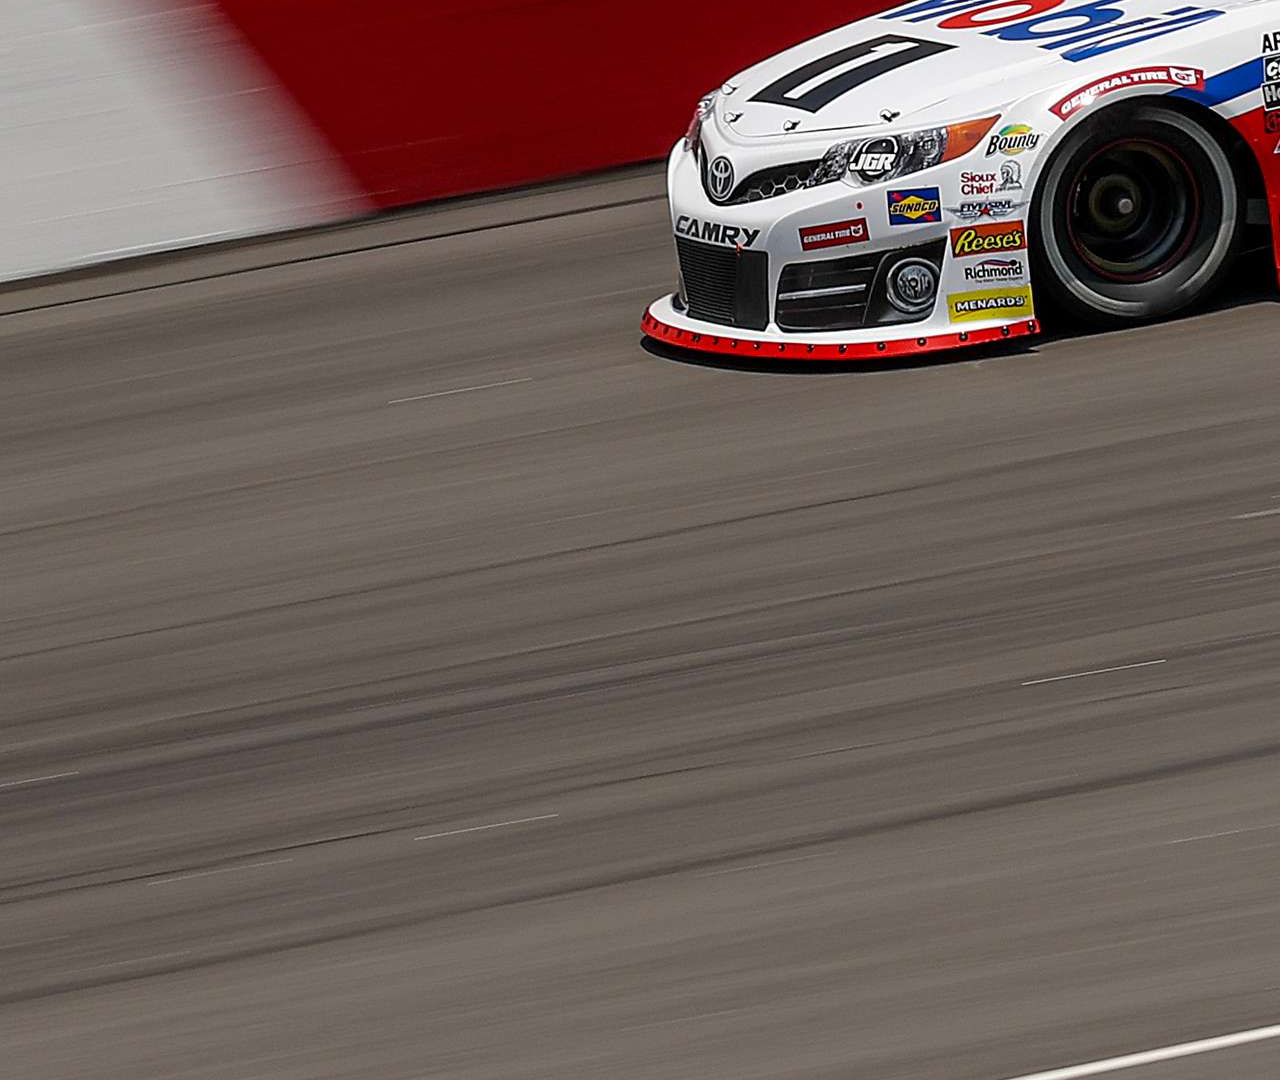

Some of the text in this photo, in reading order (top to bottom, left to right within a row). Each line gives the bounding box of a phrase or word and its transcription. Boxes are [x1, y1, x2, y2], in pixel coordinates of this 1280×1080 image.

[1060, 71, 1168, 115] GENERAL TIRE
[985, 132, 1041, 158] Bounty
[849, 152, 897, 171] JGR
[960, 171, 997, 184] Sioux
[960, 182, 995, 196] Chief
[890, 200, 939, 216] SUNOCO
[675, 214, 761, 247] CAMRY
[802, 230, 835, 244] GENERAL
[954, 229, 1022, 255] Reese's
[964, 261, 1024, 281] Richmond
[954, 296, 1025, 313] MENARDS
